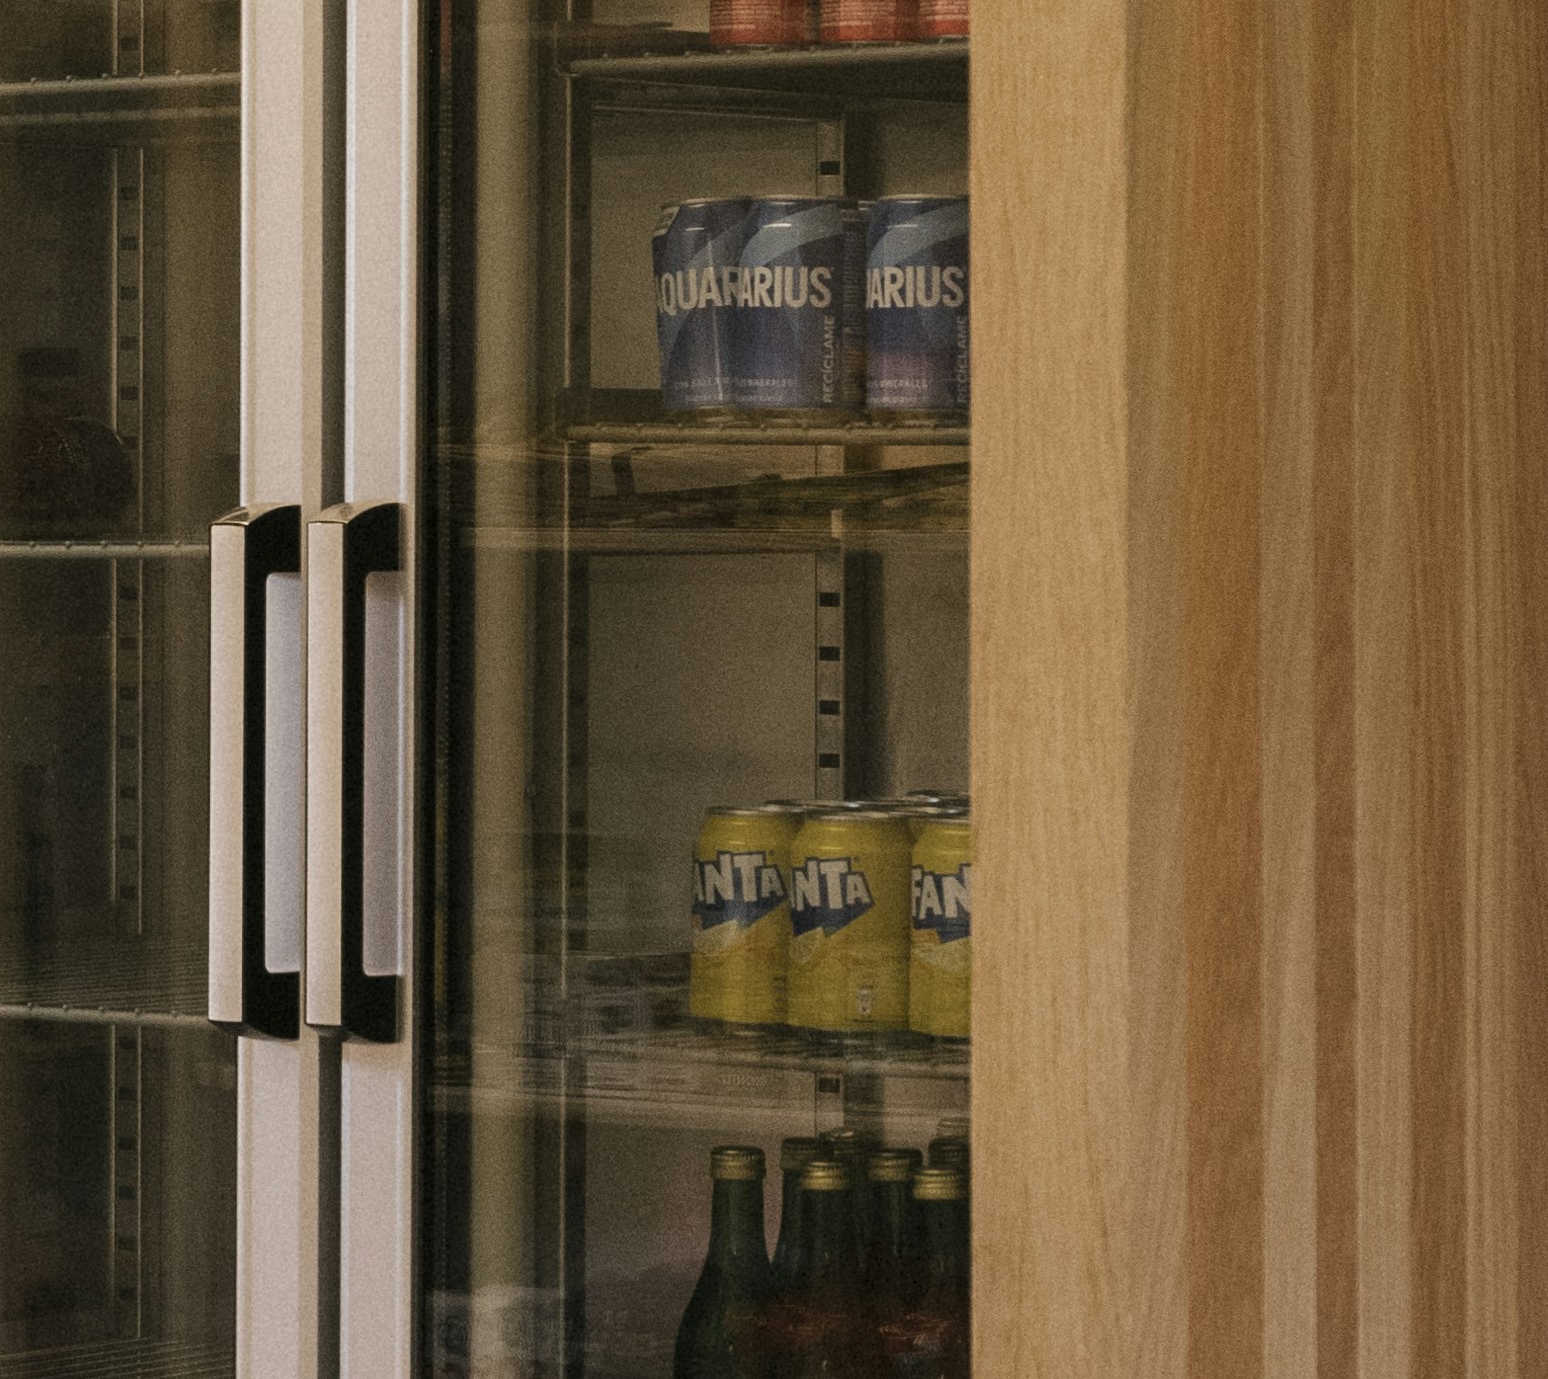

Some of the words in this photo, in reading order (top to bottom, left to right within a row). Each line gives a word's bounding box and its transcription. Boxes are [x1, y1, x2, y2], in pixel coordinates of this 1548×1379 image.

[741, 265, 832, 309] ARIUS
[865, 264, 966, 310] ARIUS
[790, 856, 872, 913] NTA
[911, 863, 971, 921] FAN
